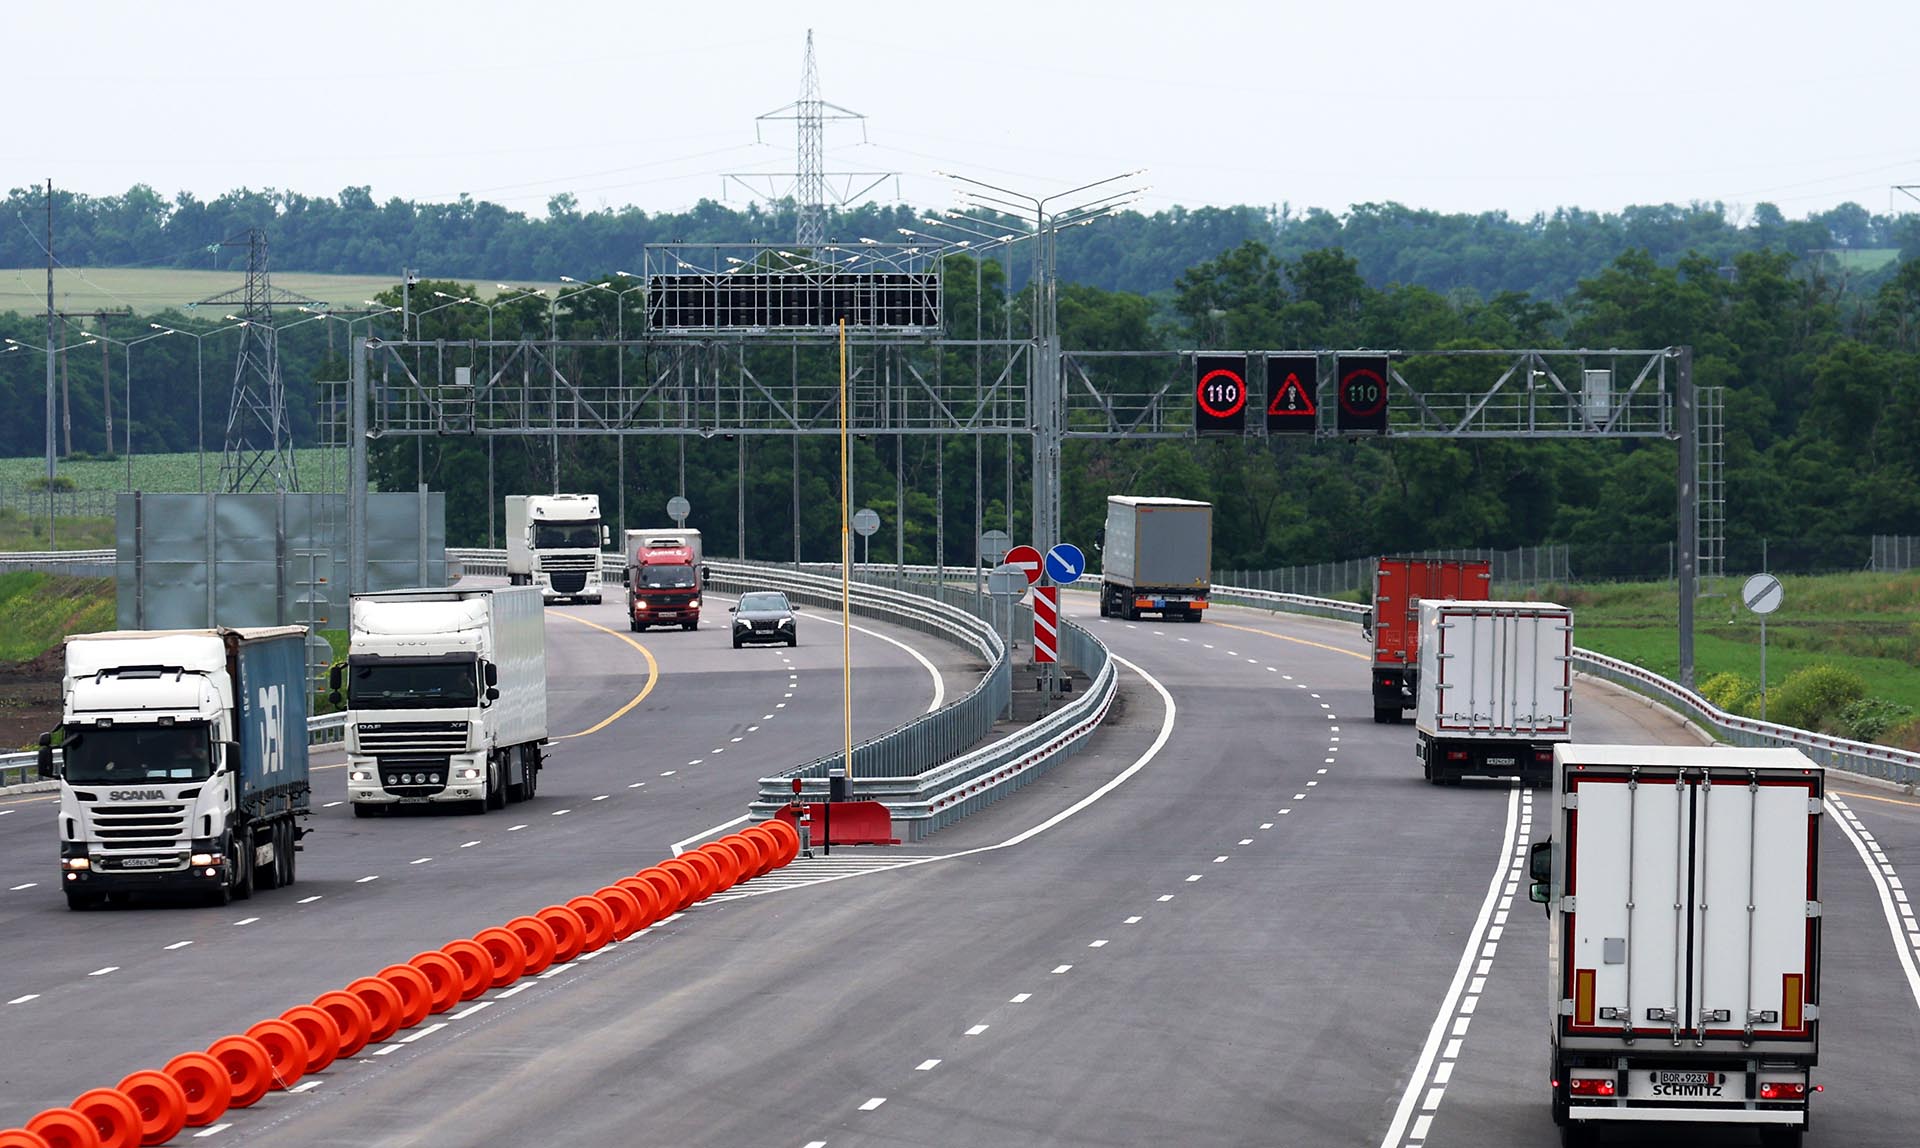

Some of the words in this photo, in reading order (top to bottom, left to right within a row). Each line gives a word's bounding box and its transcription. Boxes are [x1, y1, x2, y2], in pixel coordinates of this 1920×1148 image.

[1207, 384, 1237, 403] 110
[1348, 385, 1378, 402] 110
[258, 684, 285, 777] DSV
[109, 789, 166, 801] SCANIA
[1653, 1084, 1722, 1097] SCHMITZ
